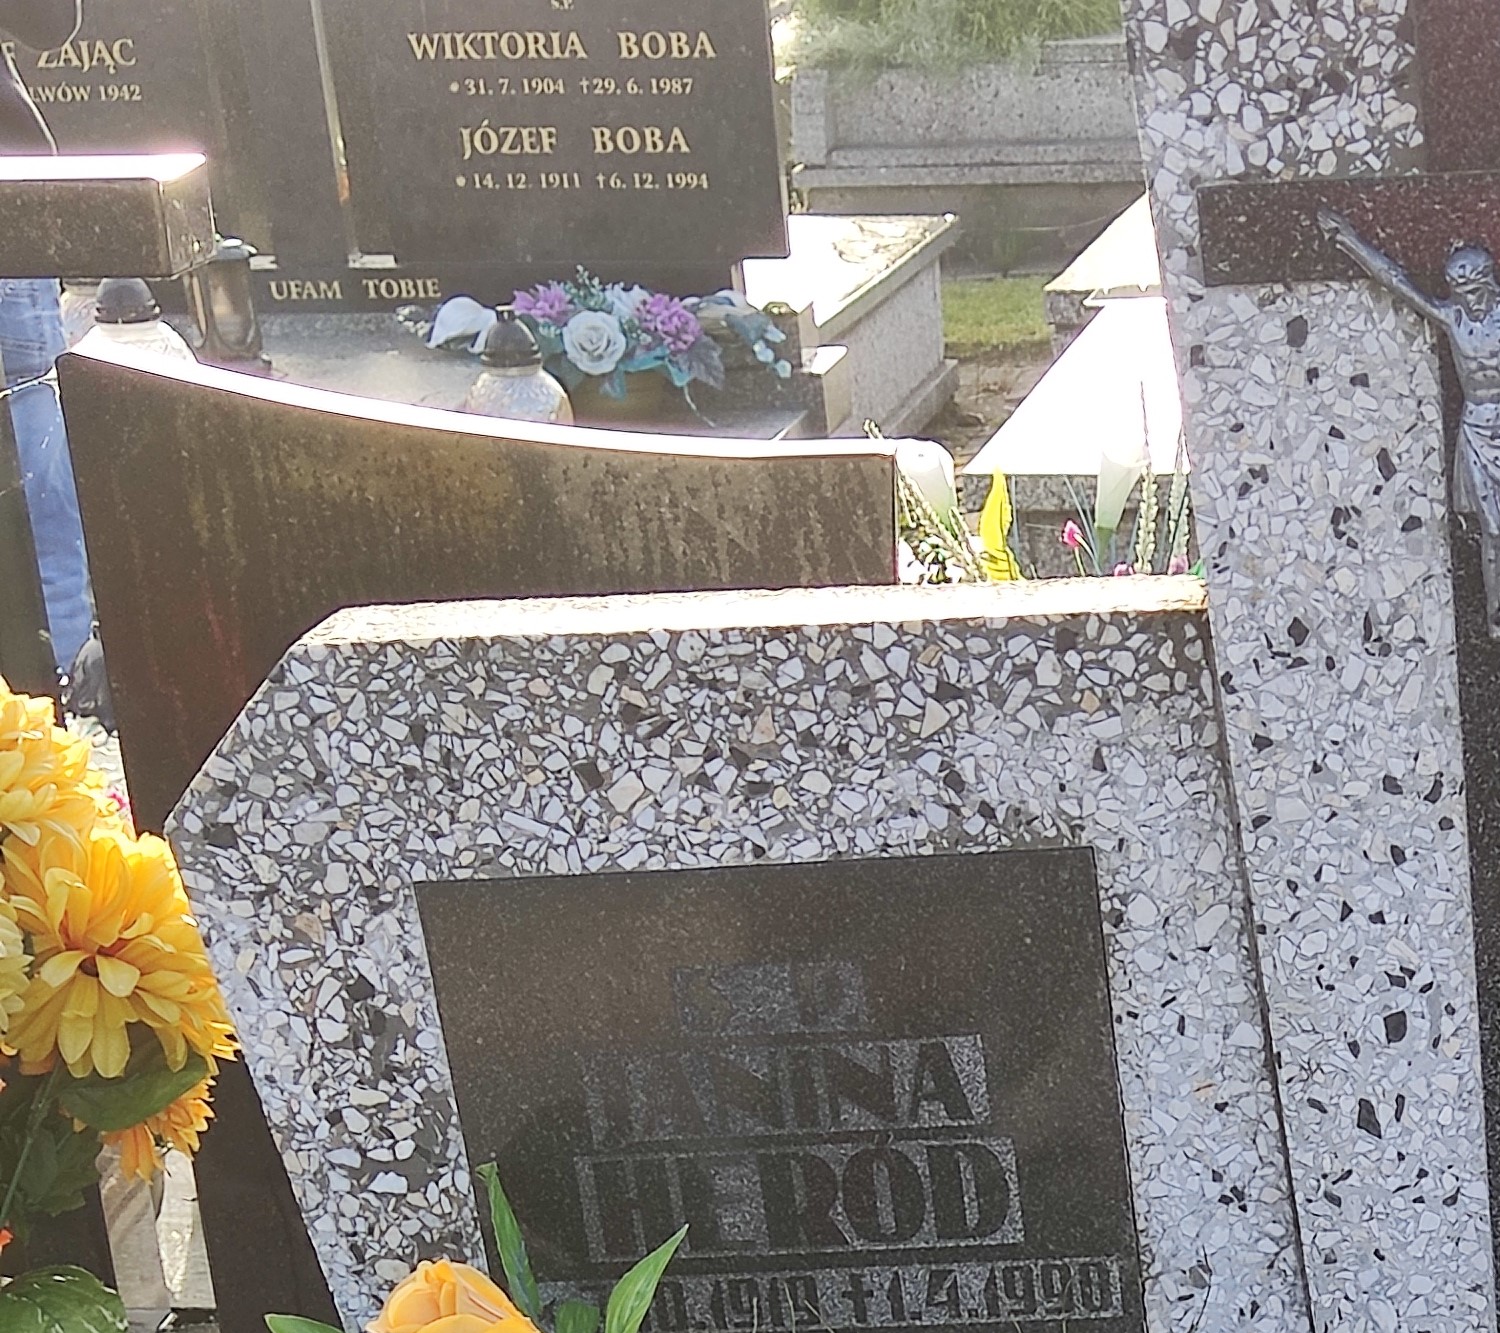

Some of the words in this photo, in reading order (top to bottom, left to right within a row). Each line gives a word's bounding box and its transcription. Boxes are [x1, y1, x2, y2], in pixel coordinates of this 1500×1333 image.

[407, 31, 588, 60] WIKTORIA
[617, 30, 716, 59] BOBA
[99, 84, 142, 101] 1942
[522, 78, 565, 95] 1904
[650, 77, 693, 95] 1987
[459, 118, 558, 160] JÓZEF
[591, 126, 691, 154] BOBA
[539, 172, 581, 189] 1911
[666, 171, 709, 189] 1994
[269, 279, 343, 300] UFAM
[362, 278, 442, 298] TOBIE
[594, 1130, 1014, 1256] HERÓD
